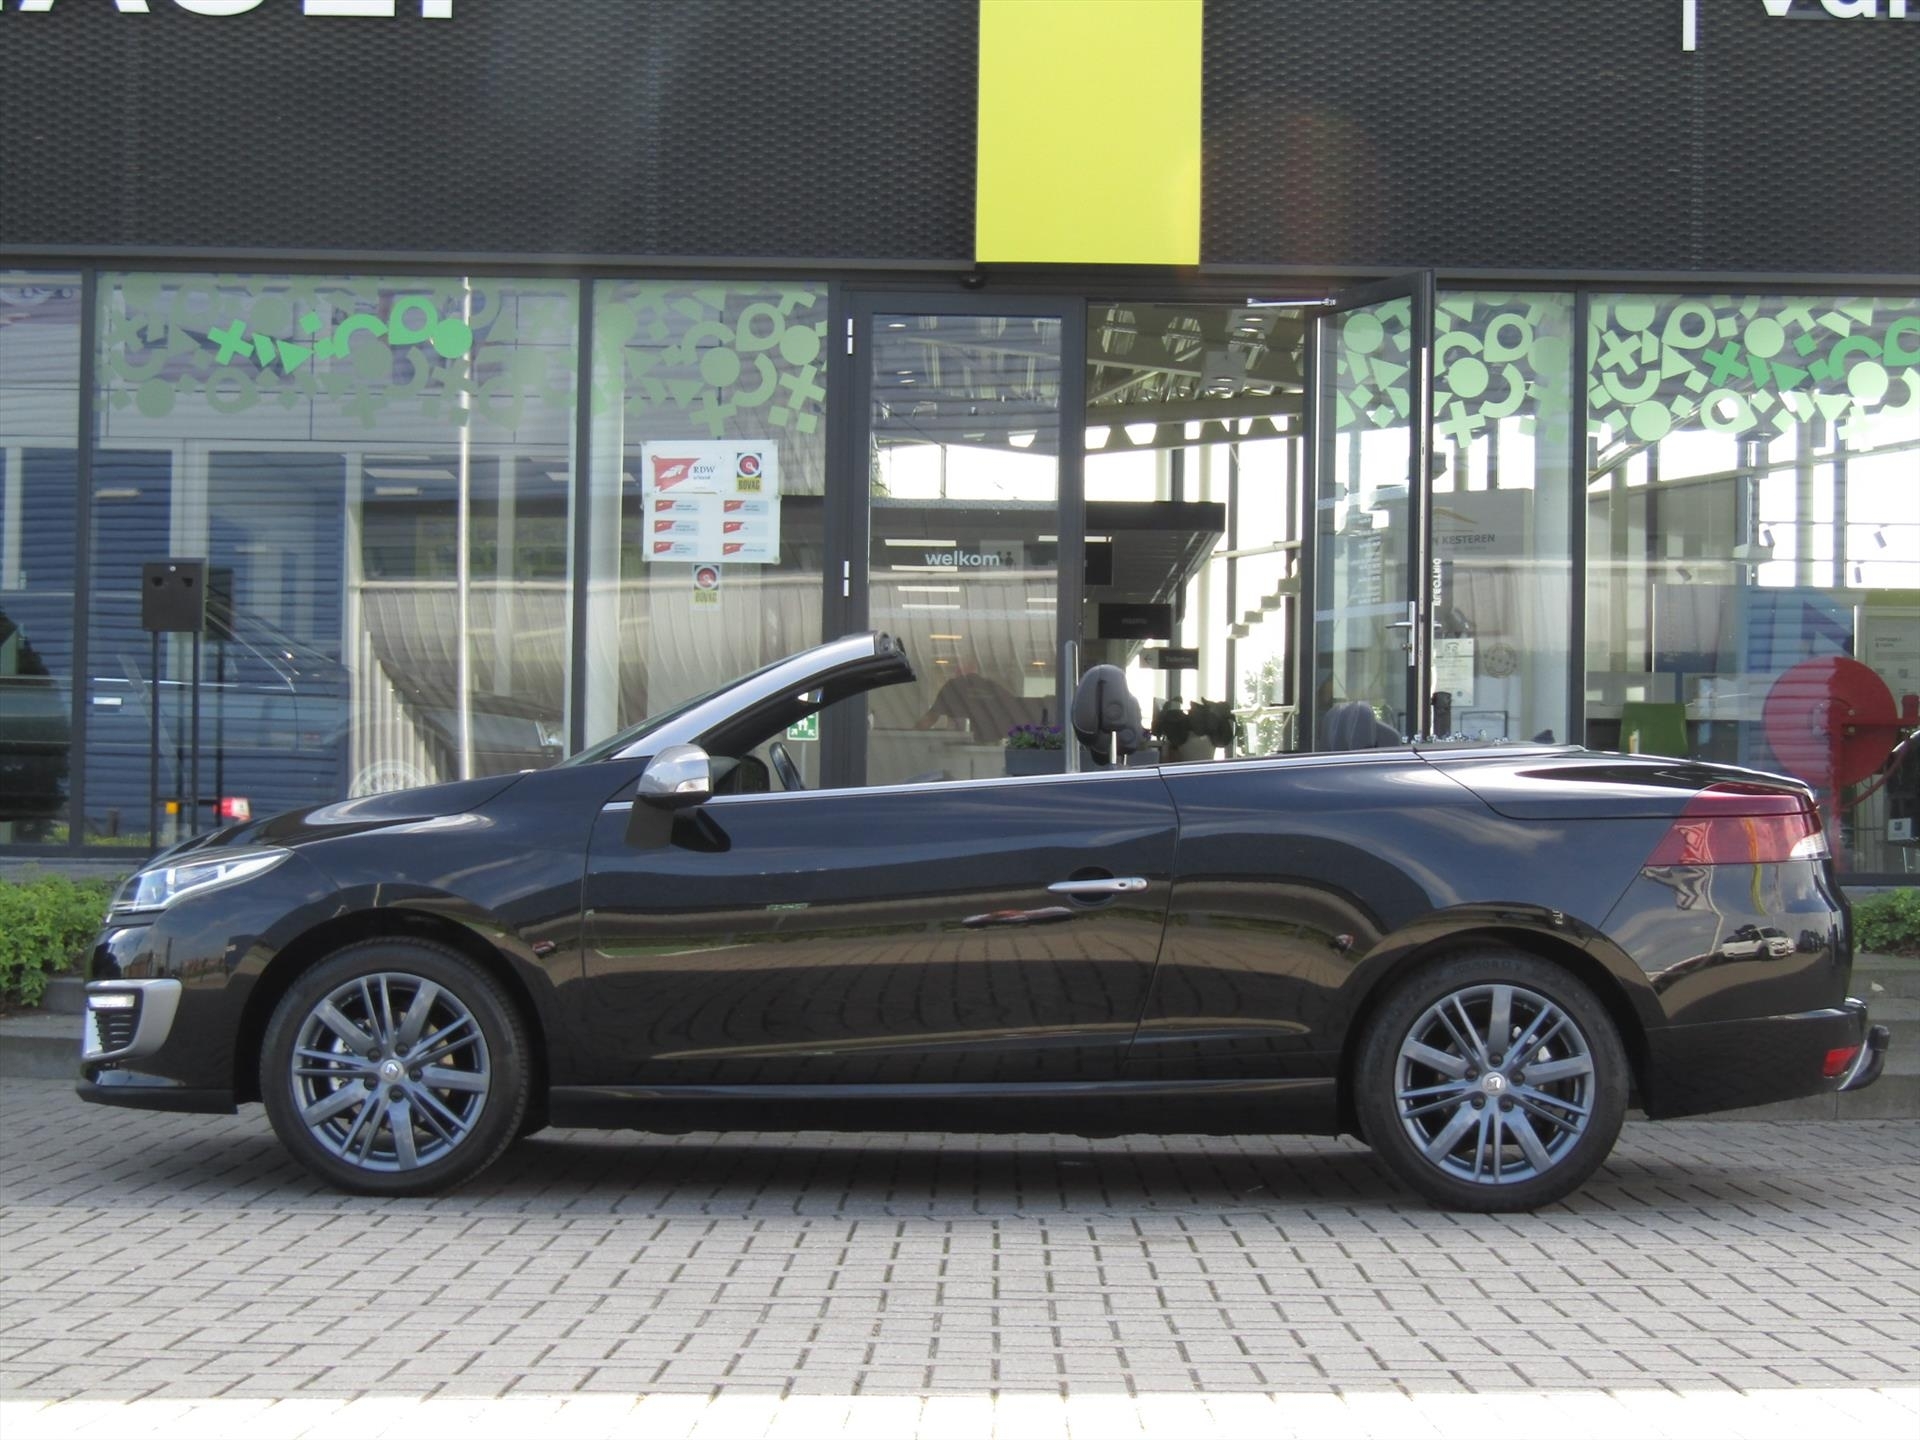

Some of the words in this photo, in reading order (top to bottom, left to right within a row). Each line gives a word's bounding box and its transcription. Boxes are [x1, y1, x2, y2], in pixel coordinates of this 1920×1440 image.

[693, 465, 716, 474] RDW
[738, 479, 761, 490] BOVAG
[1441, 533, 1496, 545] KESTEREN
[925, 550, 1000, 566] welkom
